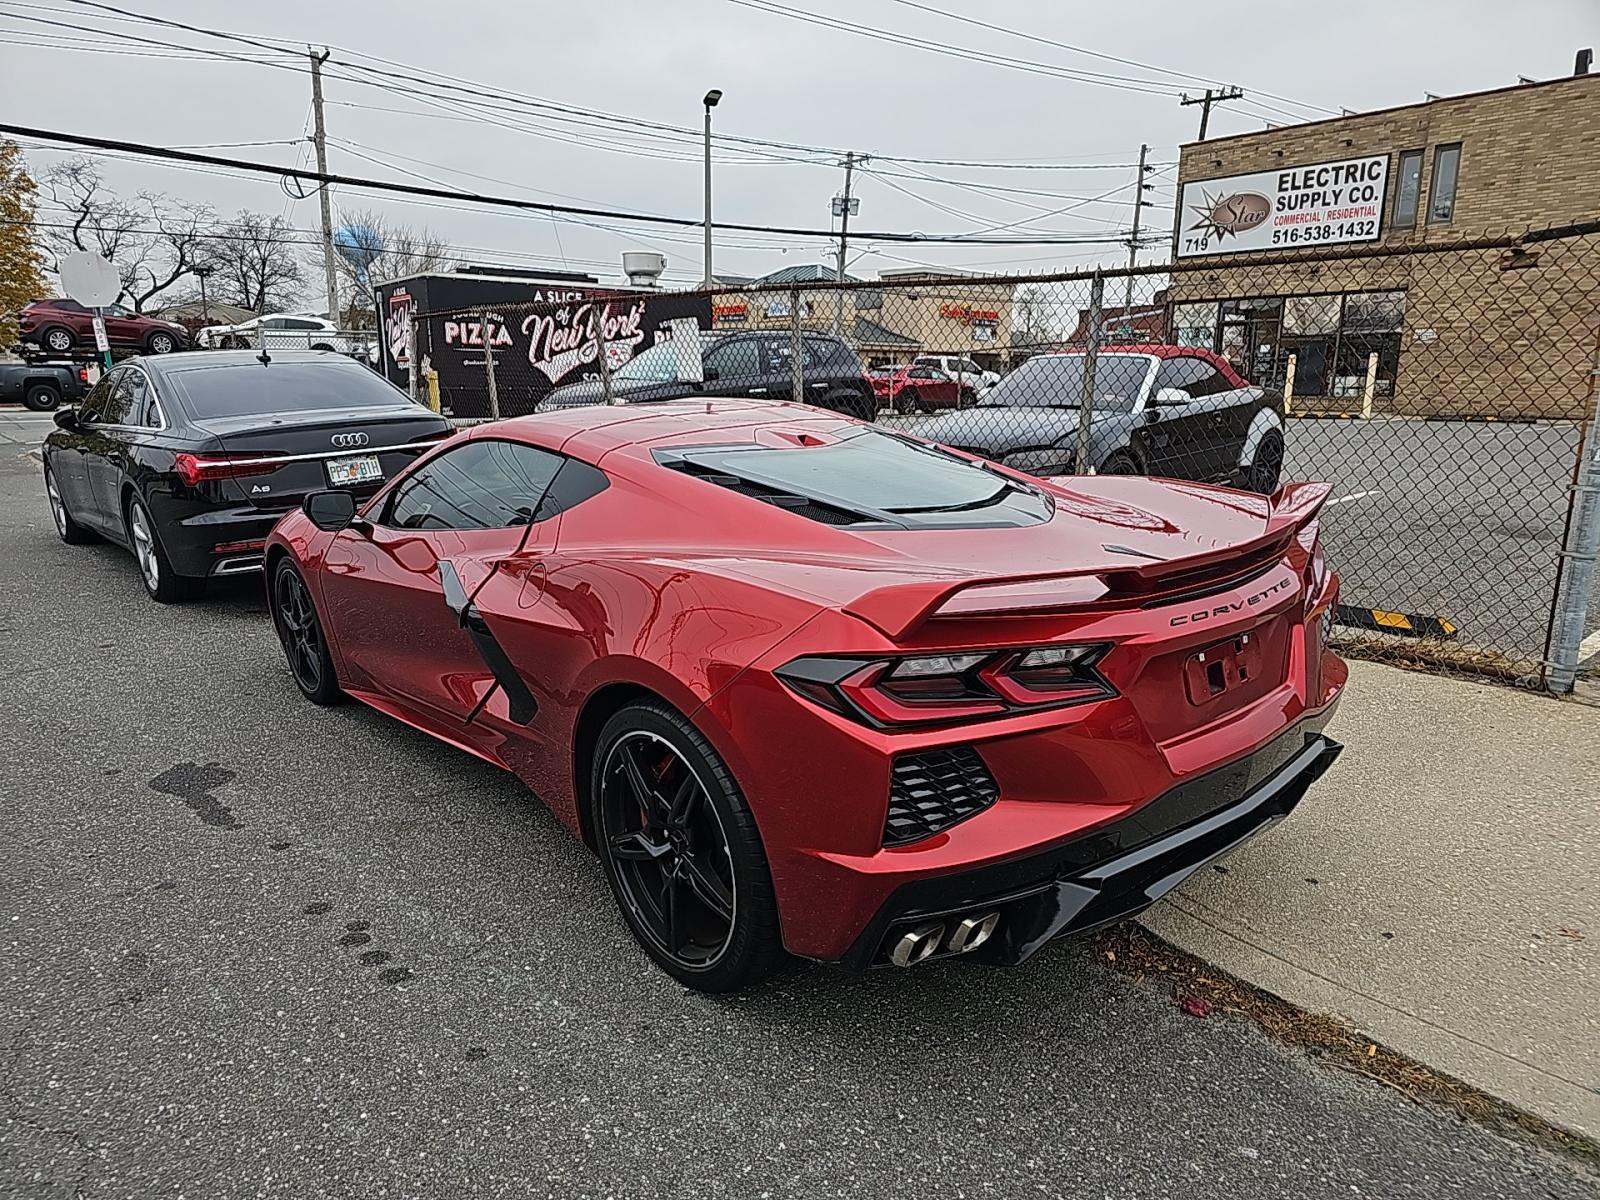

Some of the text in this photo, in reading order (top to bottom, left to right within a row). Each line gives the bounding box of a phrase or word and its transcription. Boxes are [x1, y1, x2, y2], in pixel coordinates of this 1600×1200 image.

[1277, 160, 1382, 193] ELECTRIC
[1214, 194, 1266, 225] Star
[1275, 184, 1379, 212] SUPPLY CO.
[1273, 210, 1321, 226] COMMERCIAL
[1326, 205, 1377, 221] RESIDENTIAL
[1185, 237, 1209, 252] 719
[1271, 220, 1375, 245] 516-538-1432
[533, 290, 583, 303] A SLICE
[555, 306, 572, 326] of
[444, 321, 514, 347] PIZZA
[521, 313, 585, 364] New
[251, 484, 271, 494] A6
[1169, 577, 1292, 627] CORVETTE
